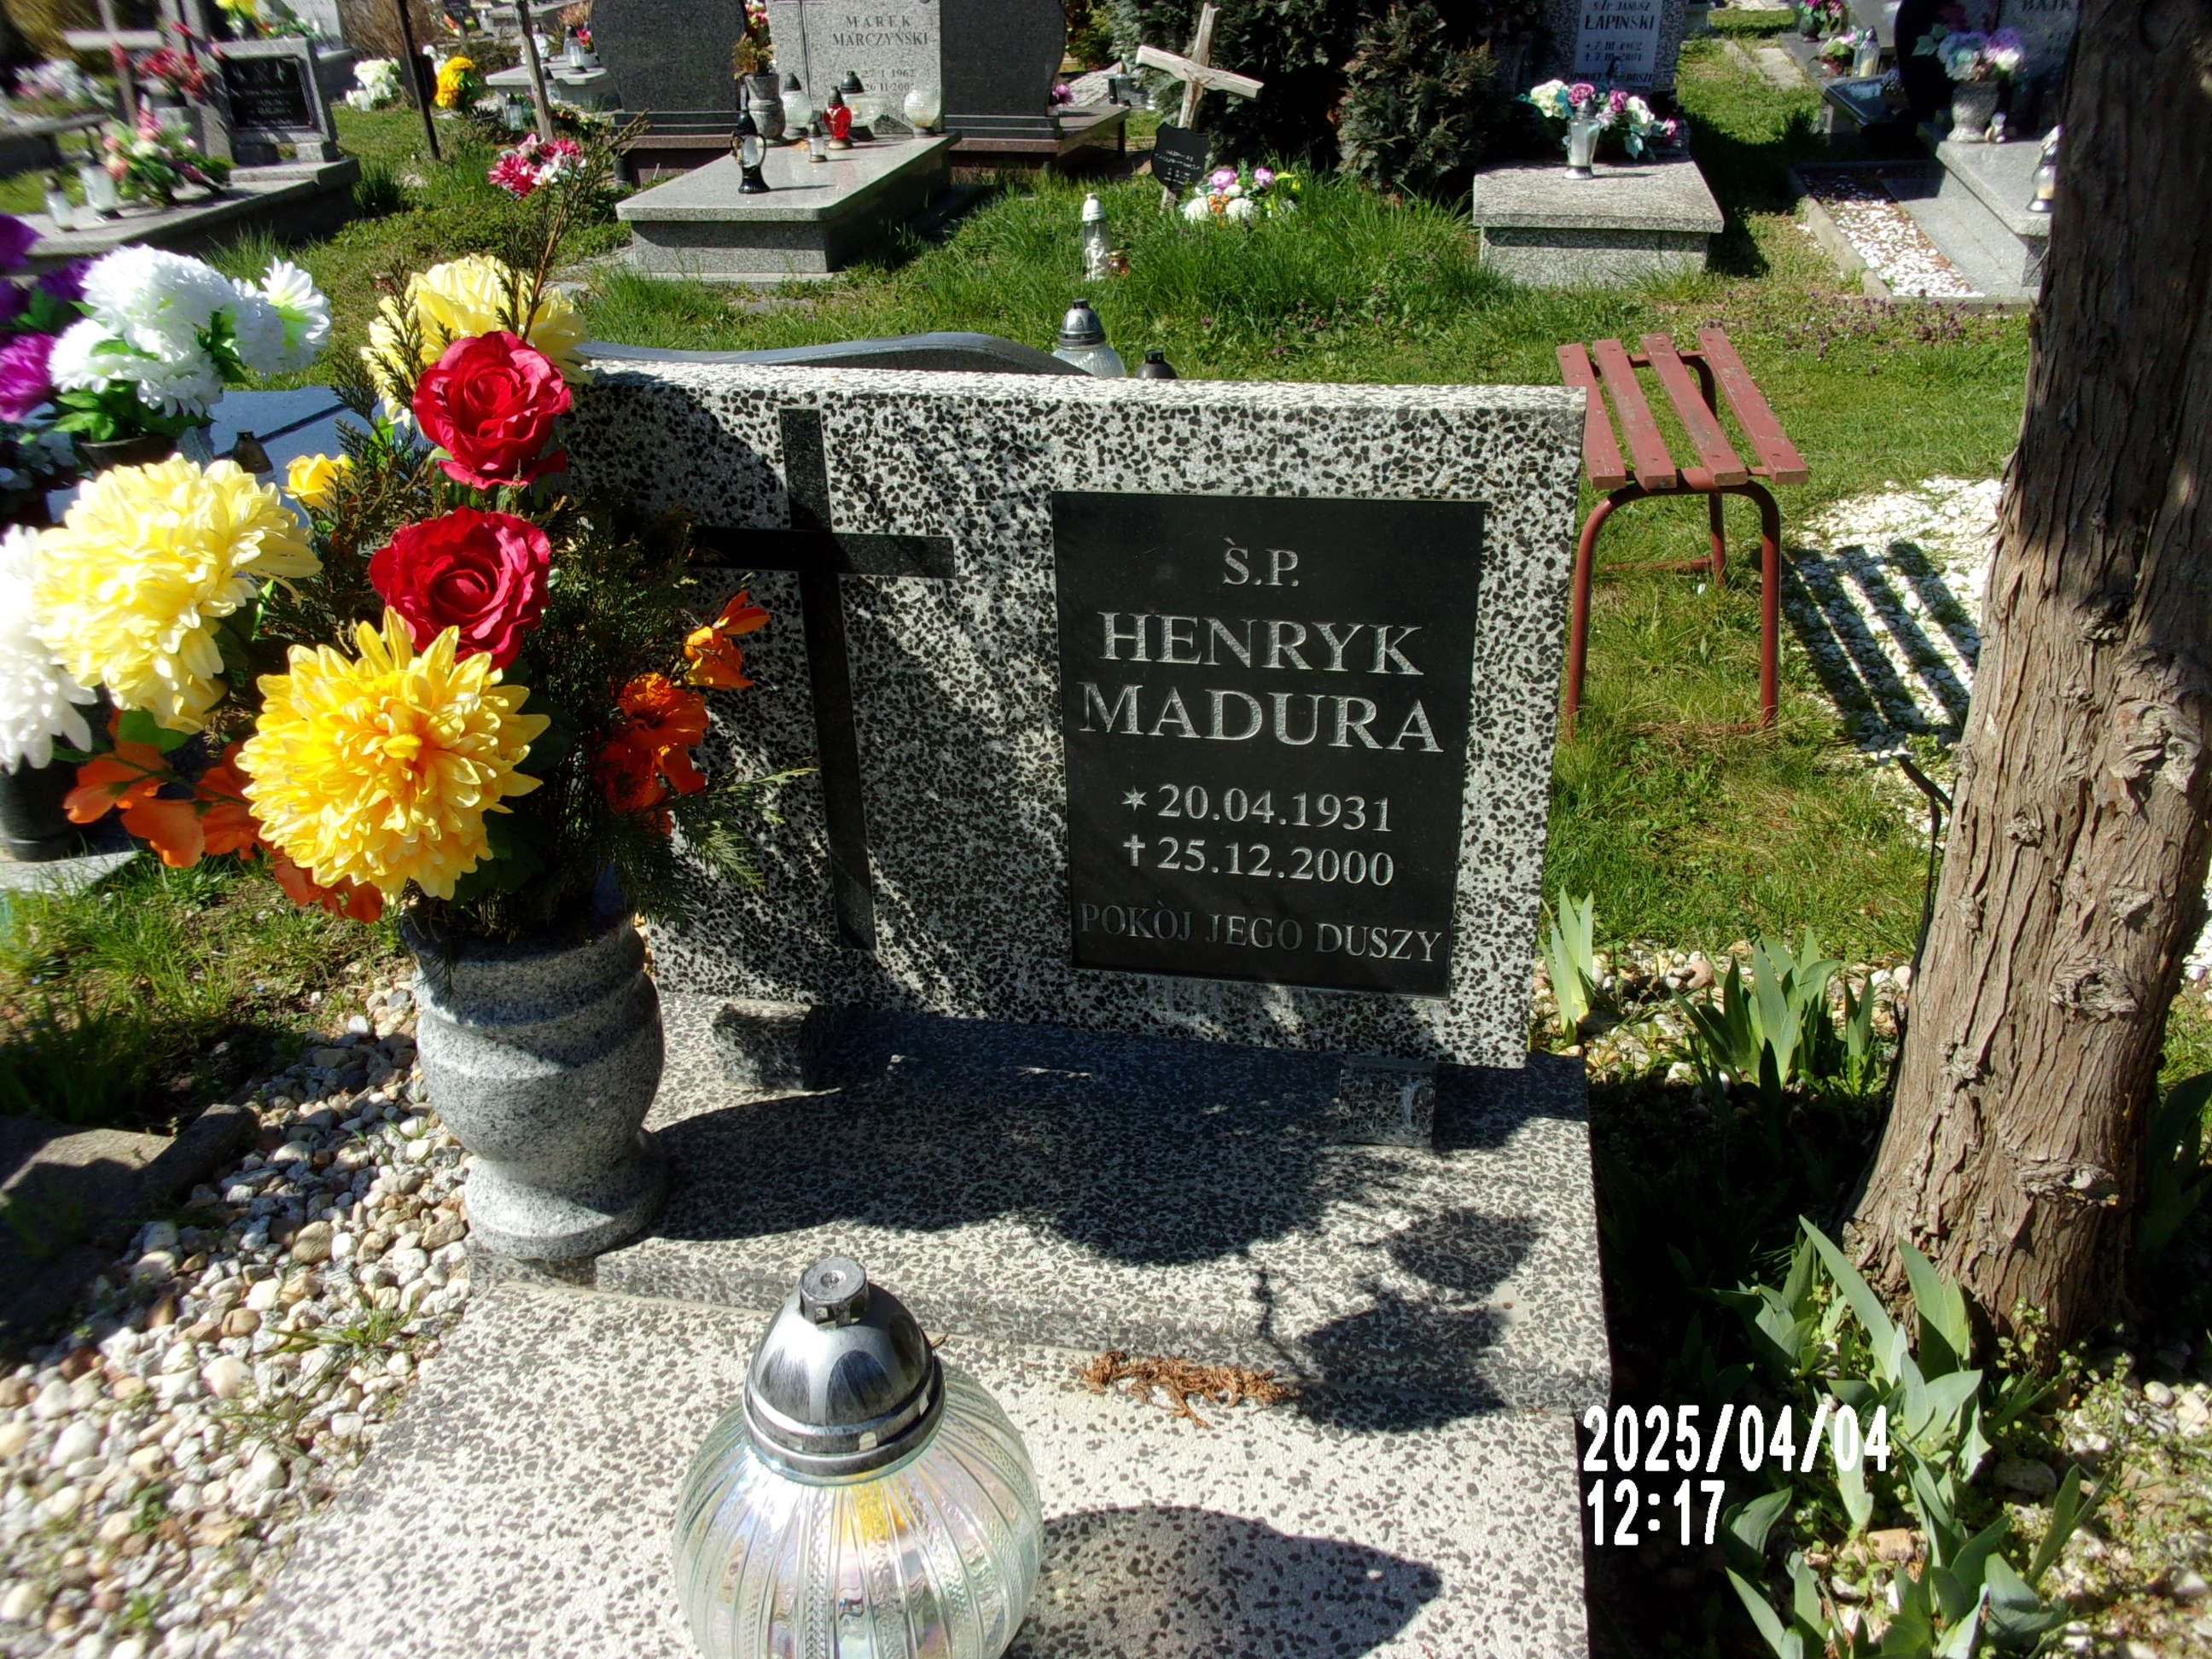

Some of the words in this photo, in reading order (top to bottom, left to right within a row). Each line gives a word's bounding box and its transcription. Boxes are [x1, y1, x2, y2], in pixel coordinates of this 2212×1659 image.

[846, 15, 911, 28] MAREK
[1097, 611, 1425, 676] HENRYK
[1077, 682, 1444, 753] MADURA
[1157, 783, 1393, 832] 20.04.1931
[1157, 836, 1394, 886] 25.12.2000
[1205, 914, 1303, 949] JEGO
[1314, 923, 1442, 962] DUSZY
